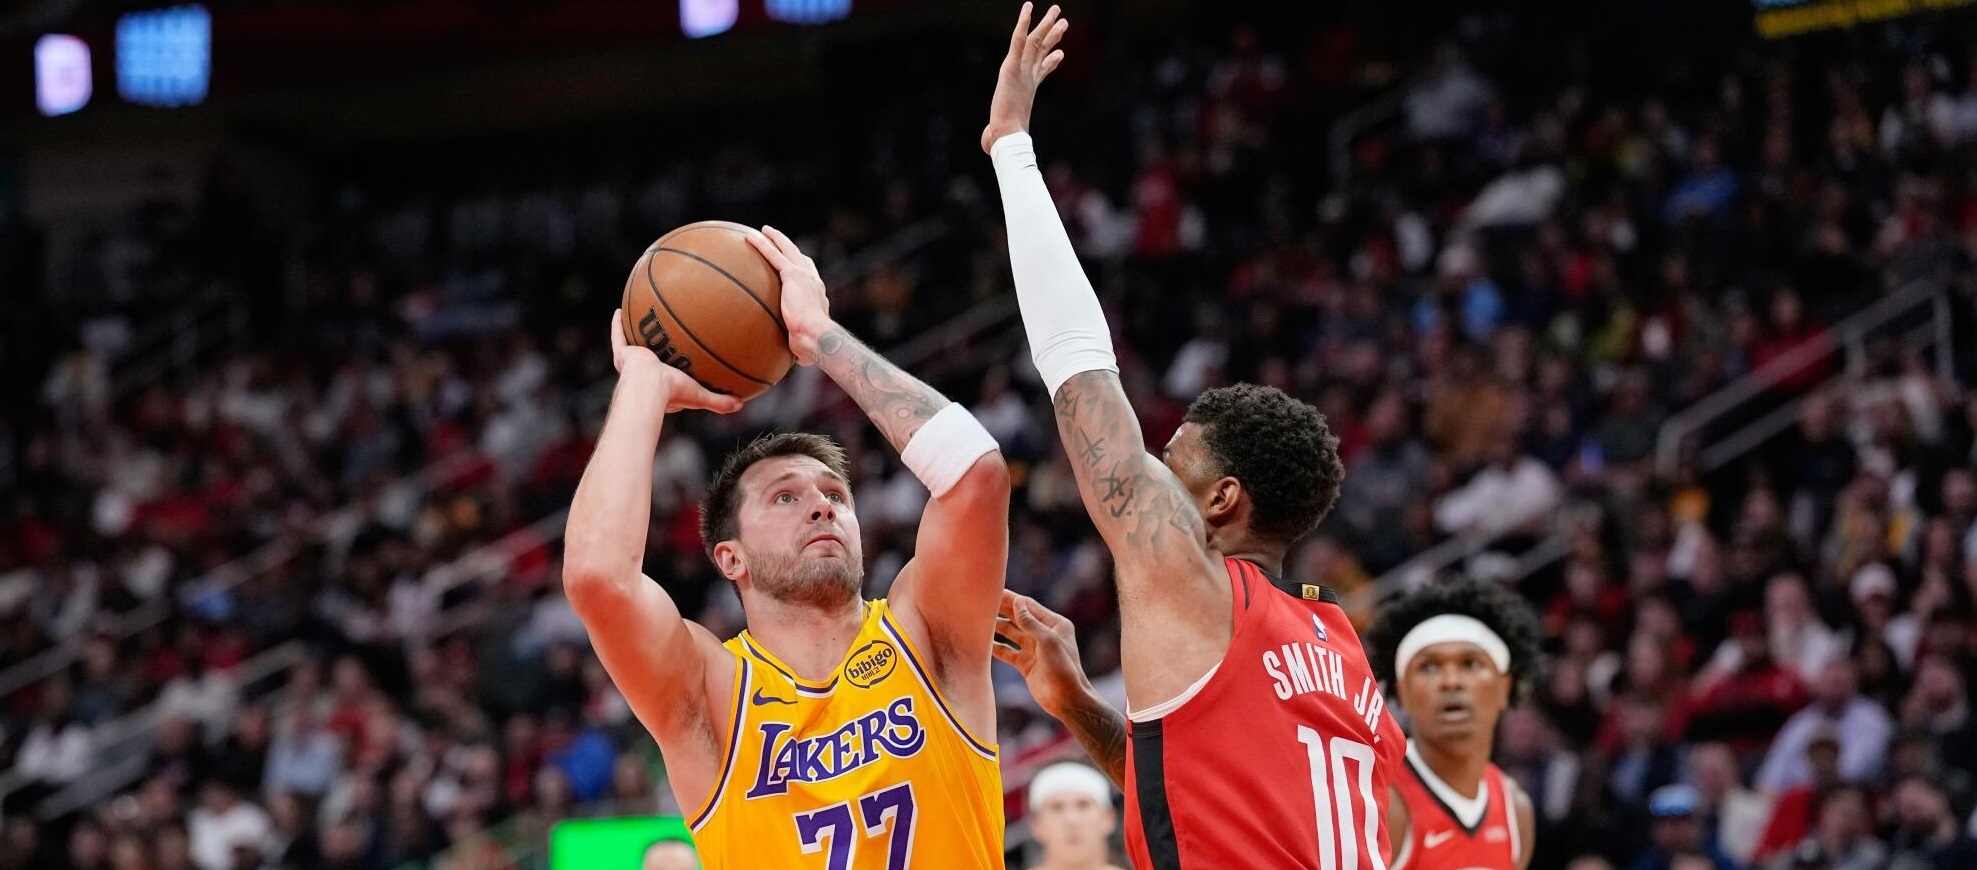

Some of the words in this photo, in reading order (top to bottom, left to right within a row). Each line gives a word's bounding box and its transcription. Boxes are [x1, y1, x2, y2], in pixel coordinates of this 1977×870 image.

[848, 648, 893, 679] bibigo
[1262, 642, 1347, 701] SMITH
[1353, 676, 1385, 744] JR.
[746, 696, 926, 800] LAKERS
[1297, 724, 1387, 870] 10
[793, 780, 918, 870] 77
